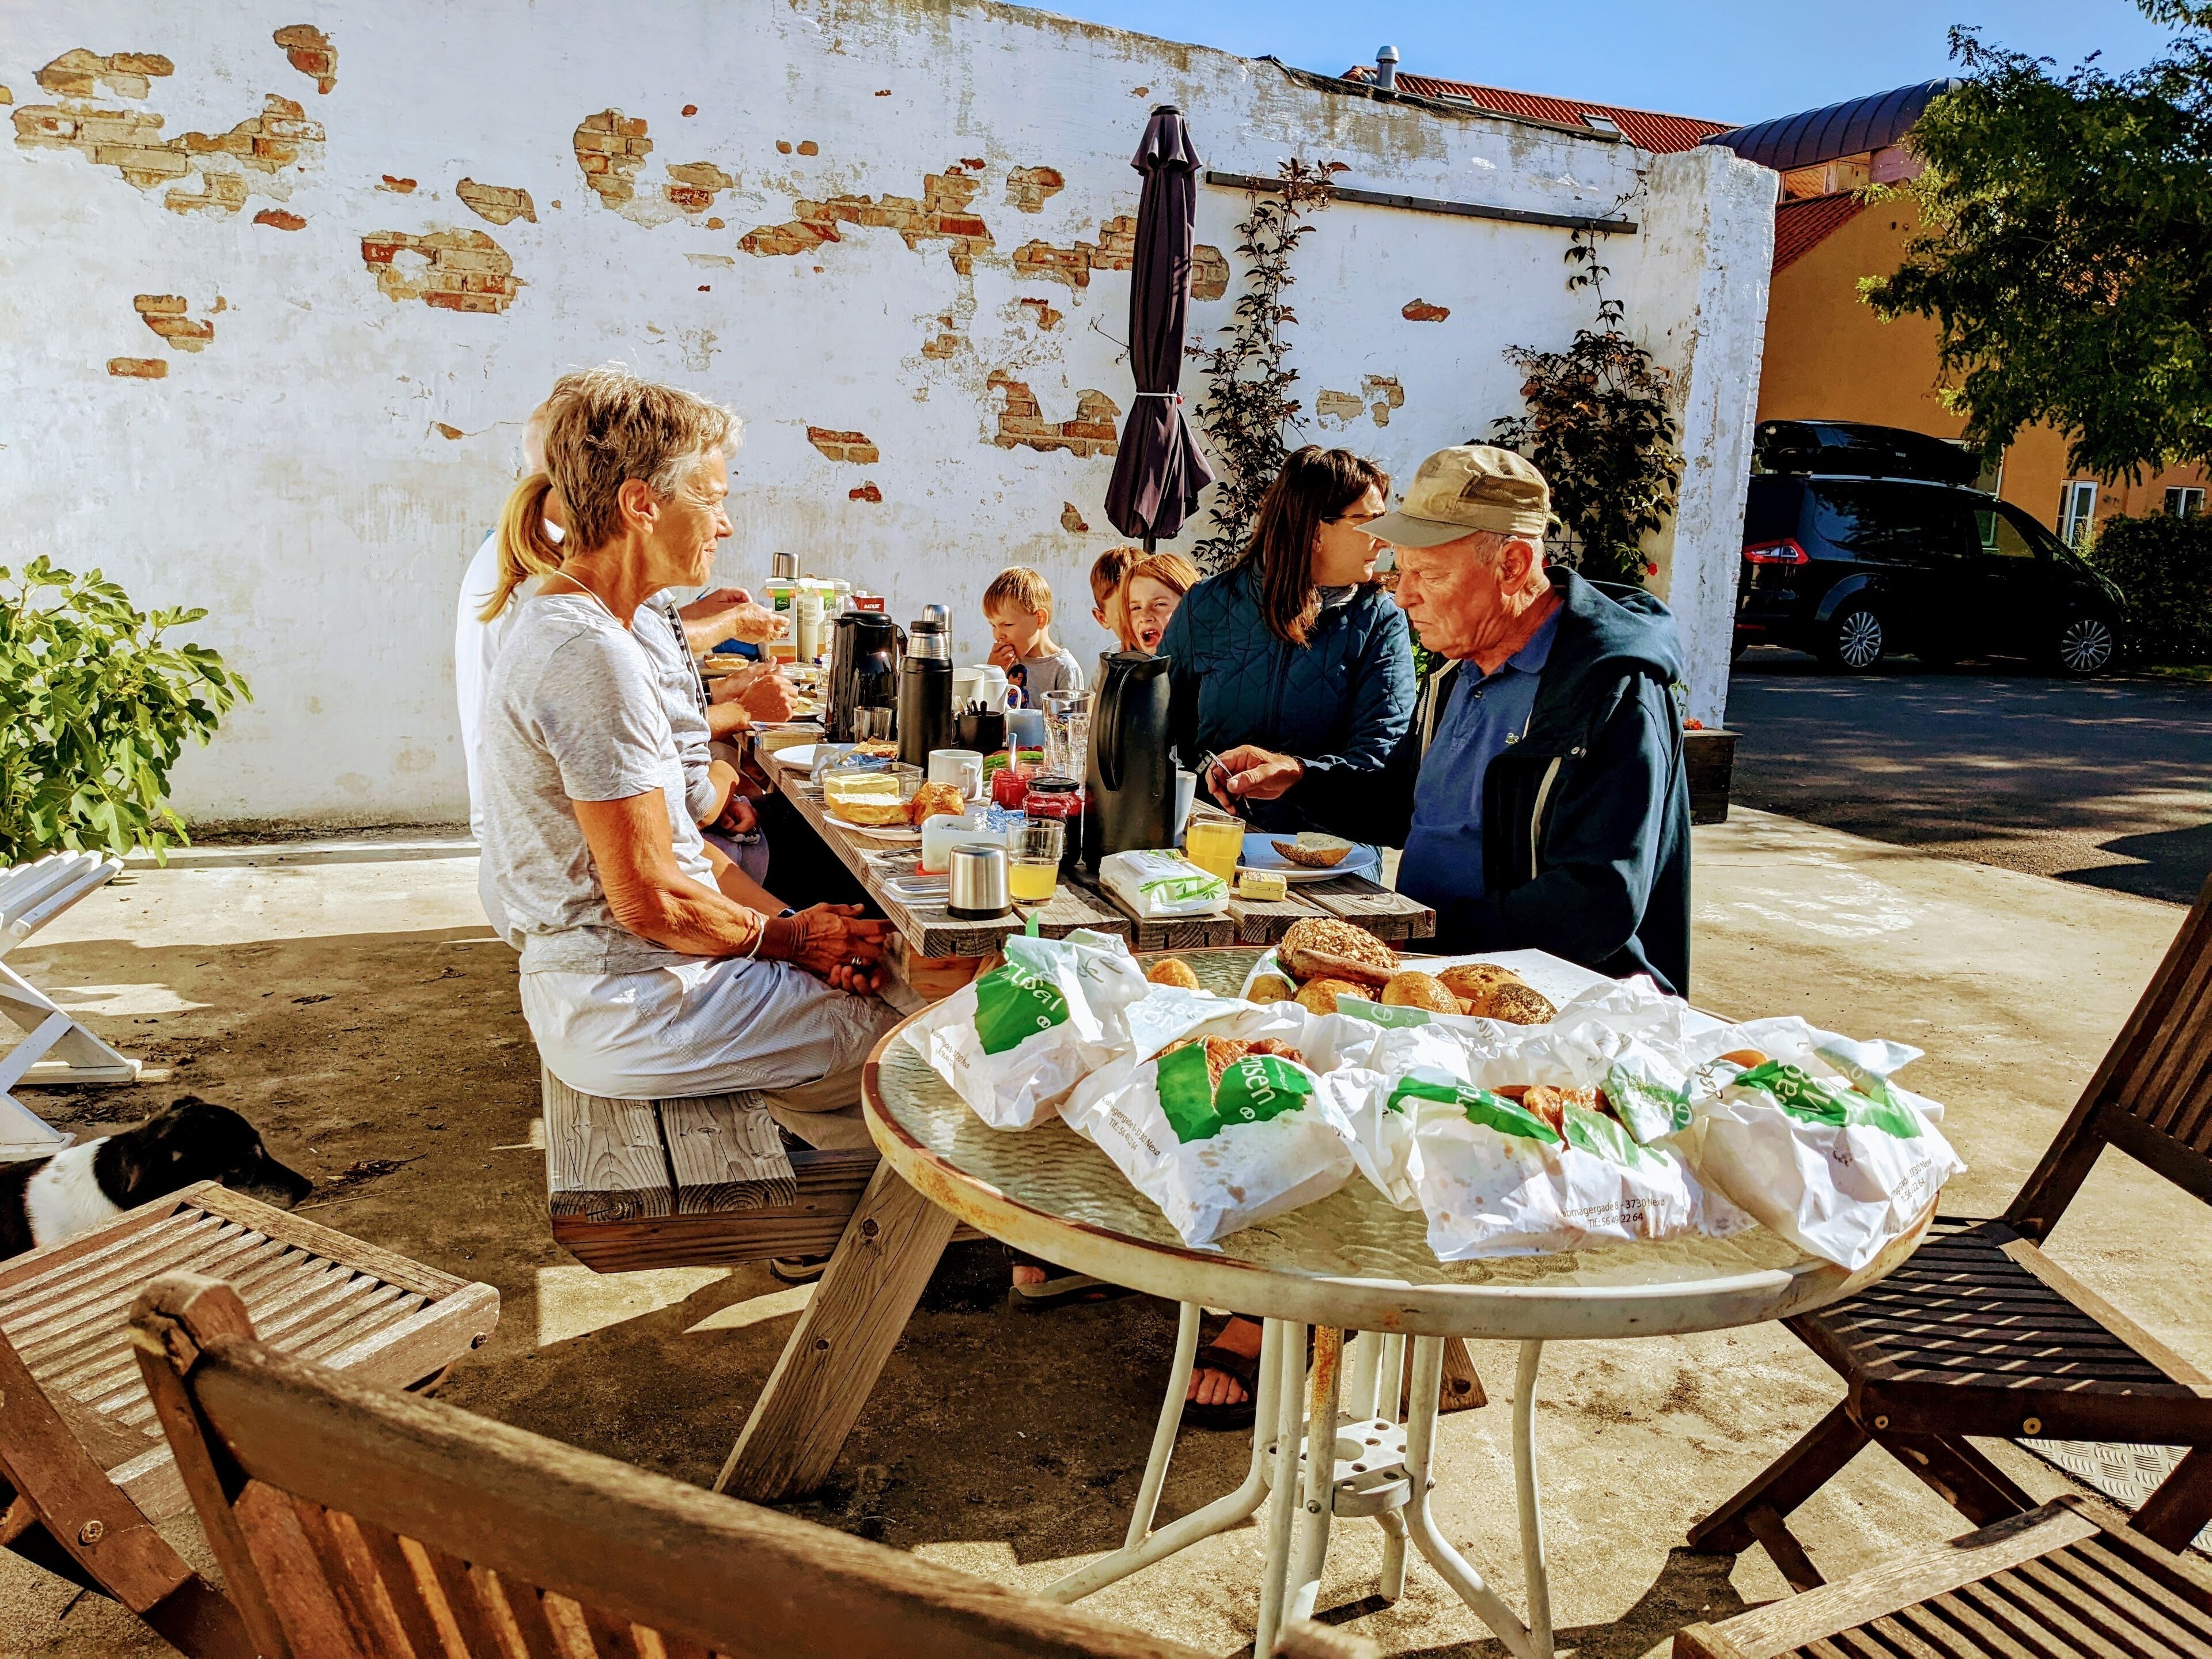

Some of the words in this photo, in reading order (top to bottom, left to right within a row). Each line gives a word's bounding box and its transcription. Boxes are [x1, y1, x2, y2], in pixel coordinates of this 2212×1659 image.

[1614, 1201, 1619, 1210] 8
[1625, 1199, 1646, 1209] 3730
[1647, 1197, 1665, 1207] Nexø
[1588, 1218, 1601, 1229] Tlf.:
[1601, 1217, 1610, 1226] 56
[1611, 1215, 1619, 1225] 49
[1620, 1214, 1631, 1224] 22
[1633, 1212, 1643, 1221] 64
